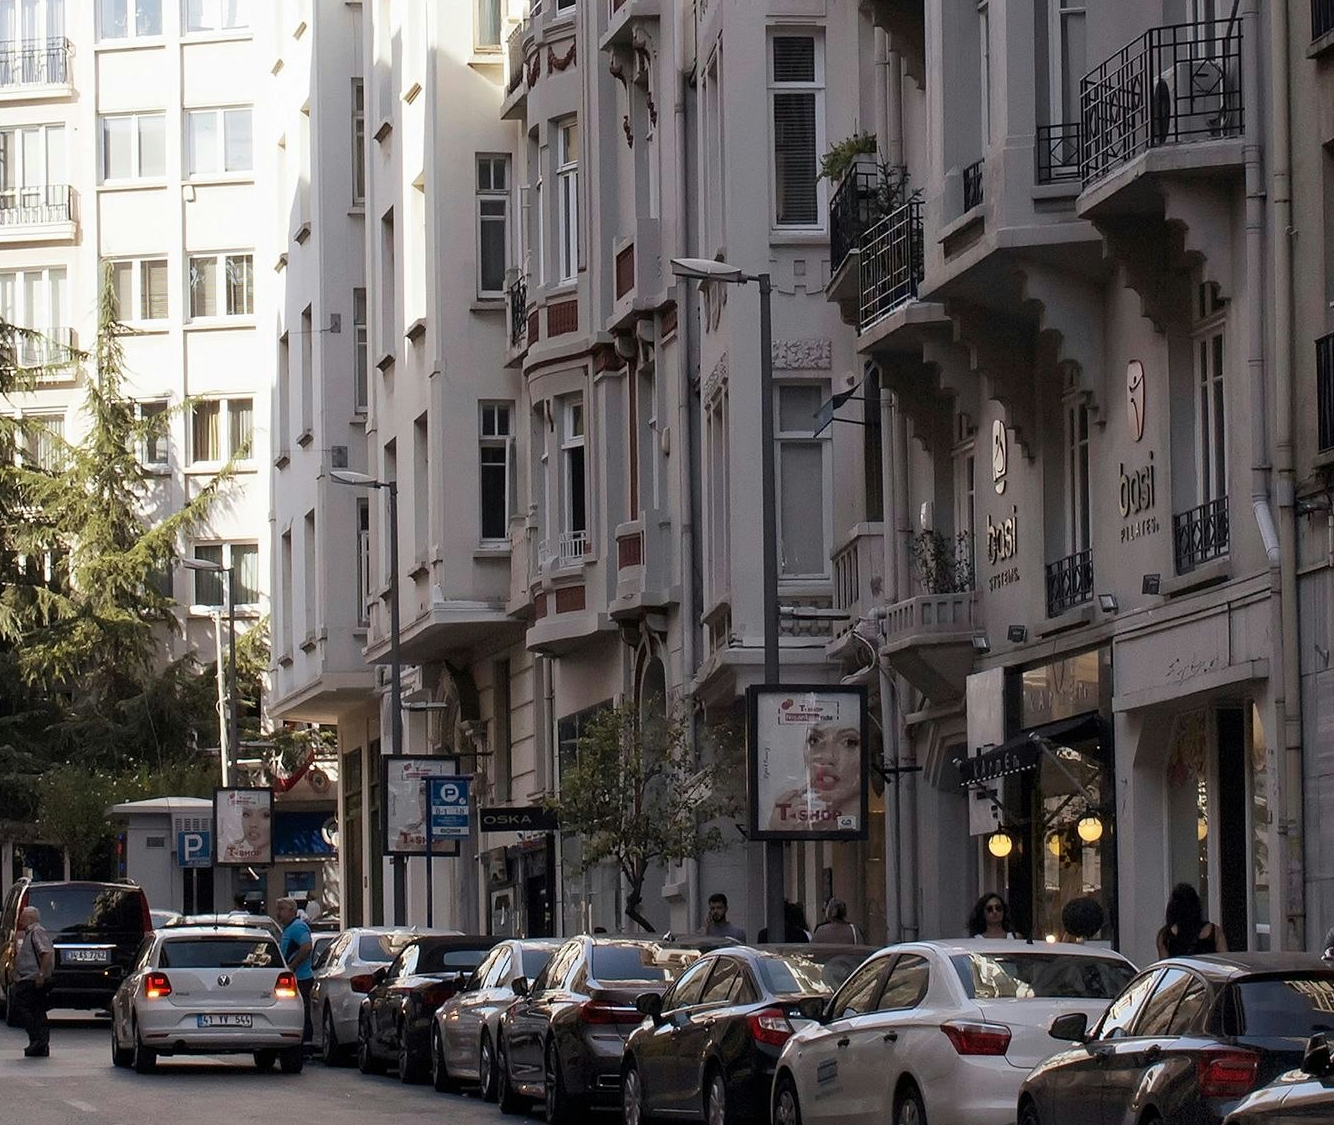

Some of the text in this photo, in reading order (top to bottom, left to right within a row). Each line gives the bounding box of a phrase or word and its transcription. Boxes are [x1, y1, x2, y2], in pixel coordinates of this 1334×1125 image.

[1119, 451, 1155, 518] basi
[986, 505, 1018, 565] basi
[444, 787, 456, 798] P
[483, 815, 532, 824] OSKA
[184, 834, 203, 861] P
[235, 1015, 250, 1024] 544
